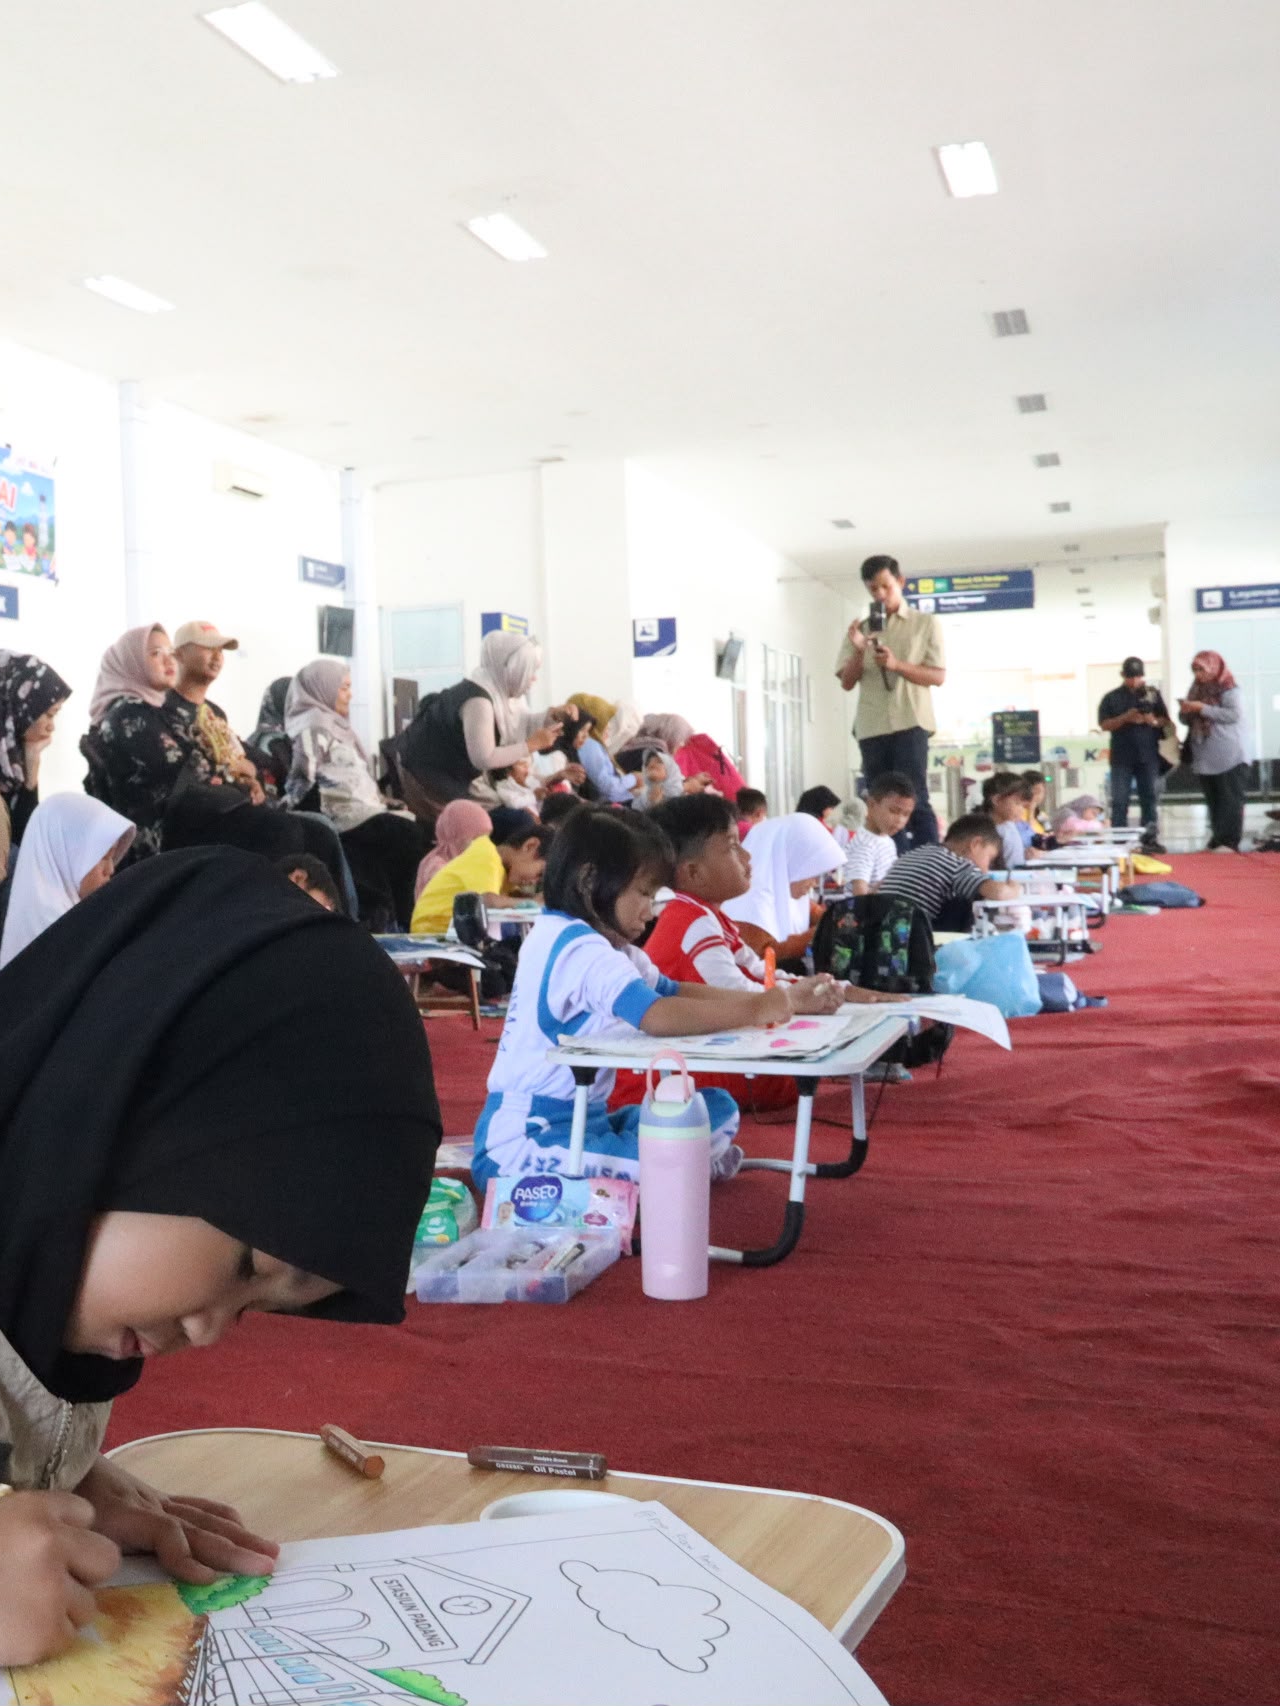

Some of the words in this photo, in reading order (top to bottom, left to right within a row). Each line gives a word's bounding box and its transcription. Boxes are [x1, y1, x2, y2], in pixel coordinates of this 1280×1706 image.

[514, 1185, 558, 1201] PASEO
[532, 1465, 547, 1474] Oil
[548, 1466, 577, 1477] Pastel
[383, 1579, 420, 1612] STASIUN
[407, 1612, 445, 1647] PADANG
